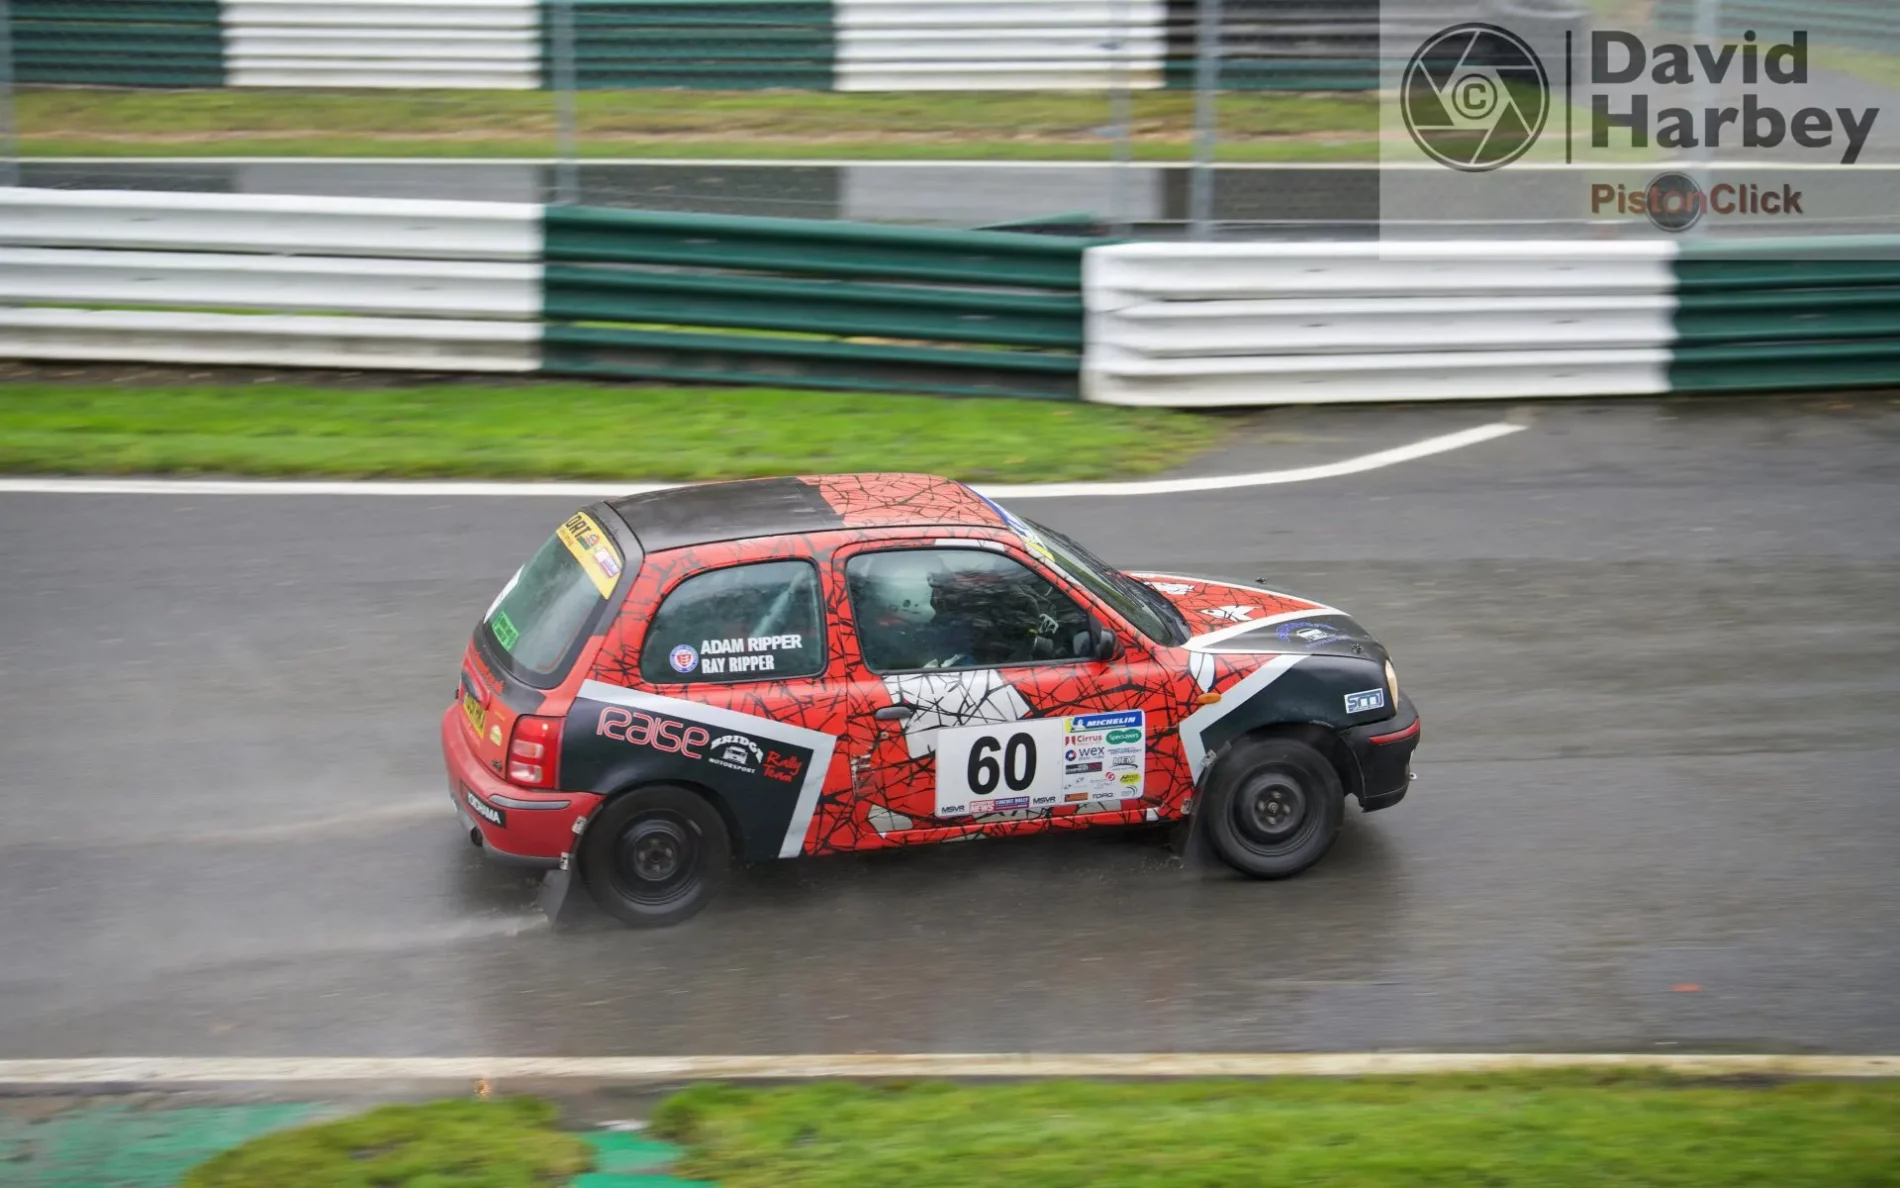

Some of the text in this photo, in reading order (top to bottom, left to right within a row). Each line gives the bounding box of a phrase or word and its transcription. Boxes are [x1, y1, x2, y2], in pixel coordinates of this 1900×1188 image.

[700, 634, 803, 655] ADAM RIPPER
[701, 657, 726, 674] RAY
[729, 654, 775, 673] RIPPER
[1086, 716, 1136, 727] MICHELIN
[1077, 735, 1103, 743] Cirrus
[1078, 747, 1105, 757] wex
[708, 757, 756, 774] MOTORSPORT
[967, 732, 1037, 795] 60
[1033, 796, 1056, 804] MSVR
[941, 805, 965, 813] MSVR
